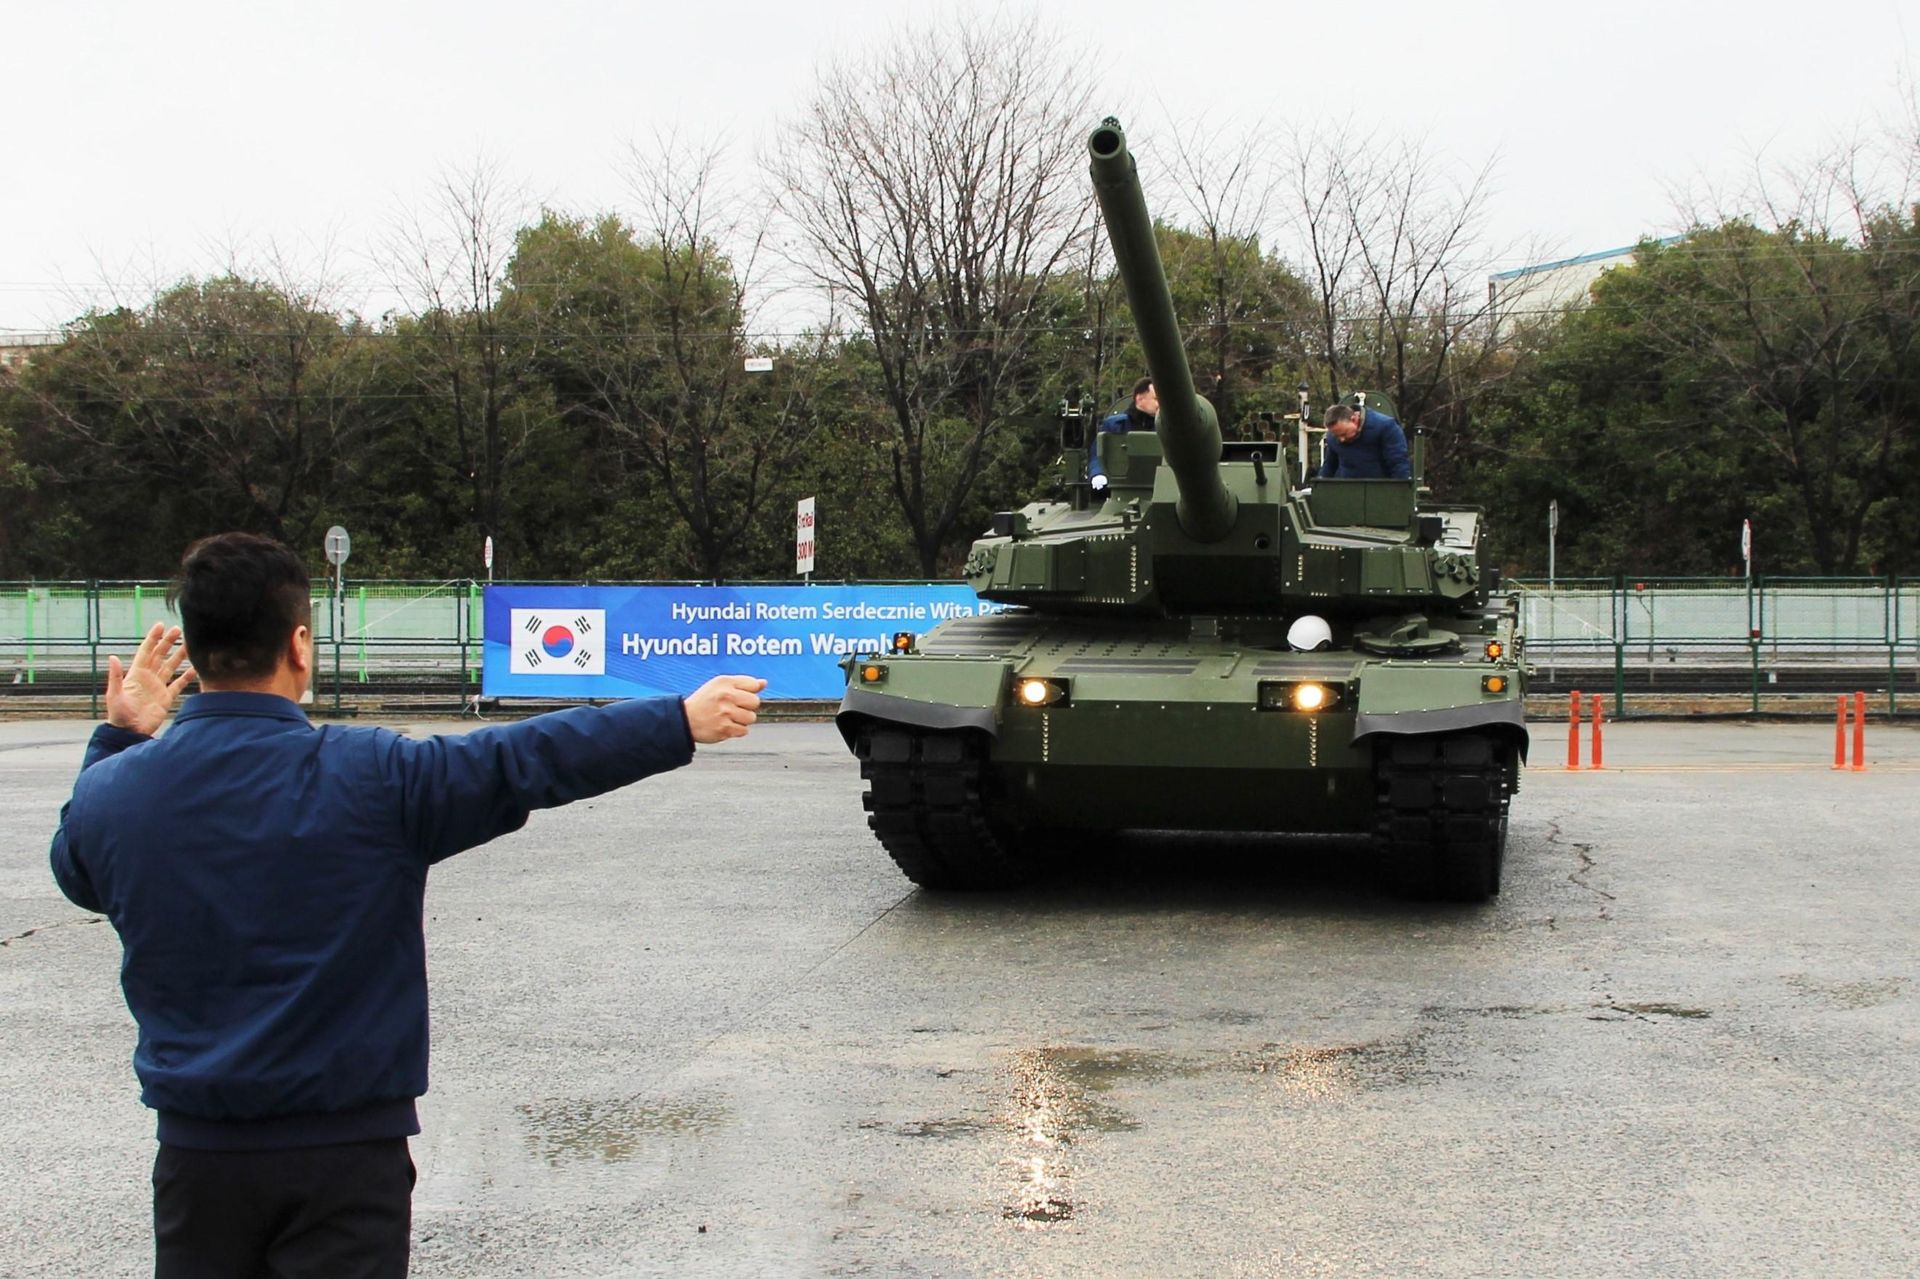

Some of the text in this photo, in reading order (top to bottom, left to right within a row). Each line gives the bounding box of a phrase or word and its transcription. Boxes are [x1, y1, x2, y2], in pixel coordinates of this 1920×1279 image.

[672, 602, 750, 624] Hyundai
[755, 602, 817, 620] Rotem
[822, 602, 926, 620] Serdecznie
[929, 602, 973, 618] Wita
[622, 633, 718, 660] Hyundai
[726, 634, 802, 655] Rotem
